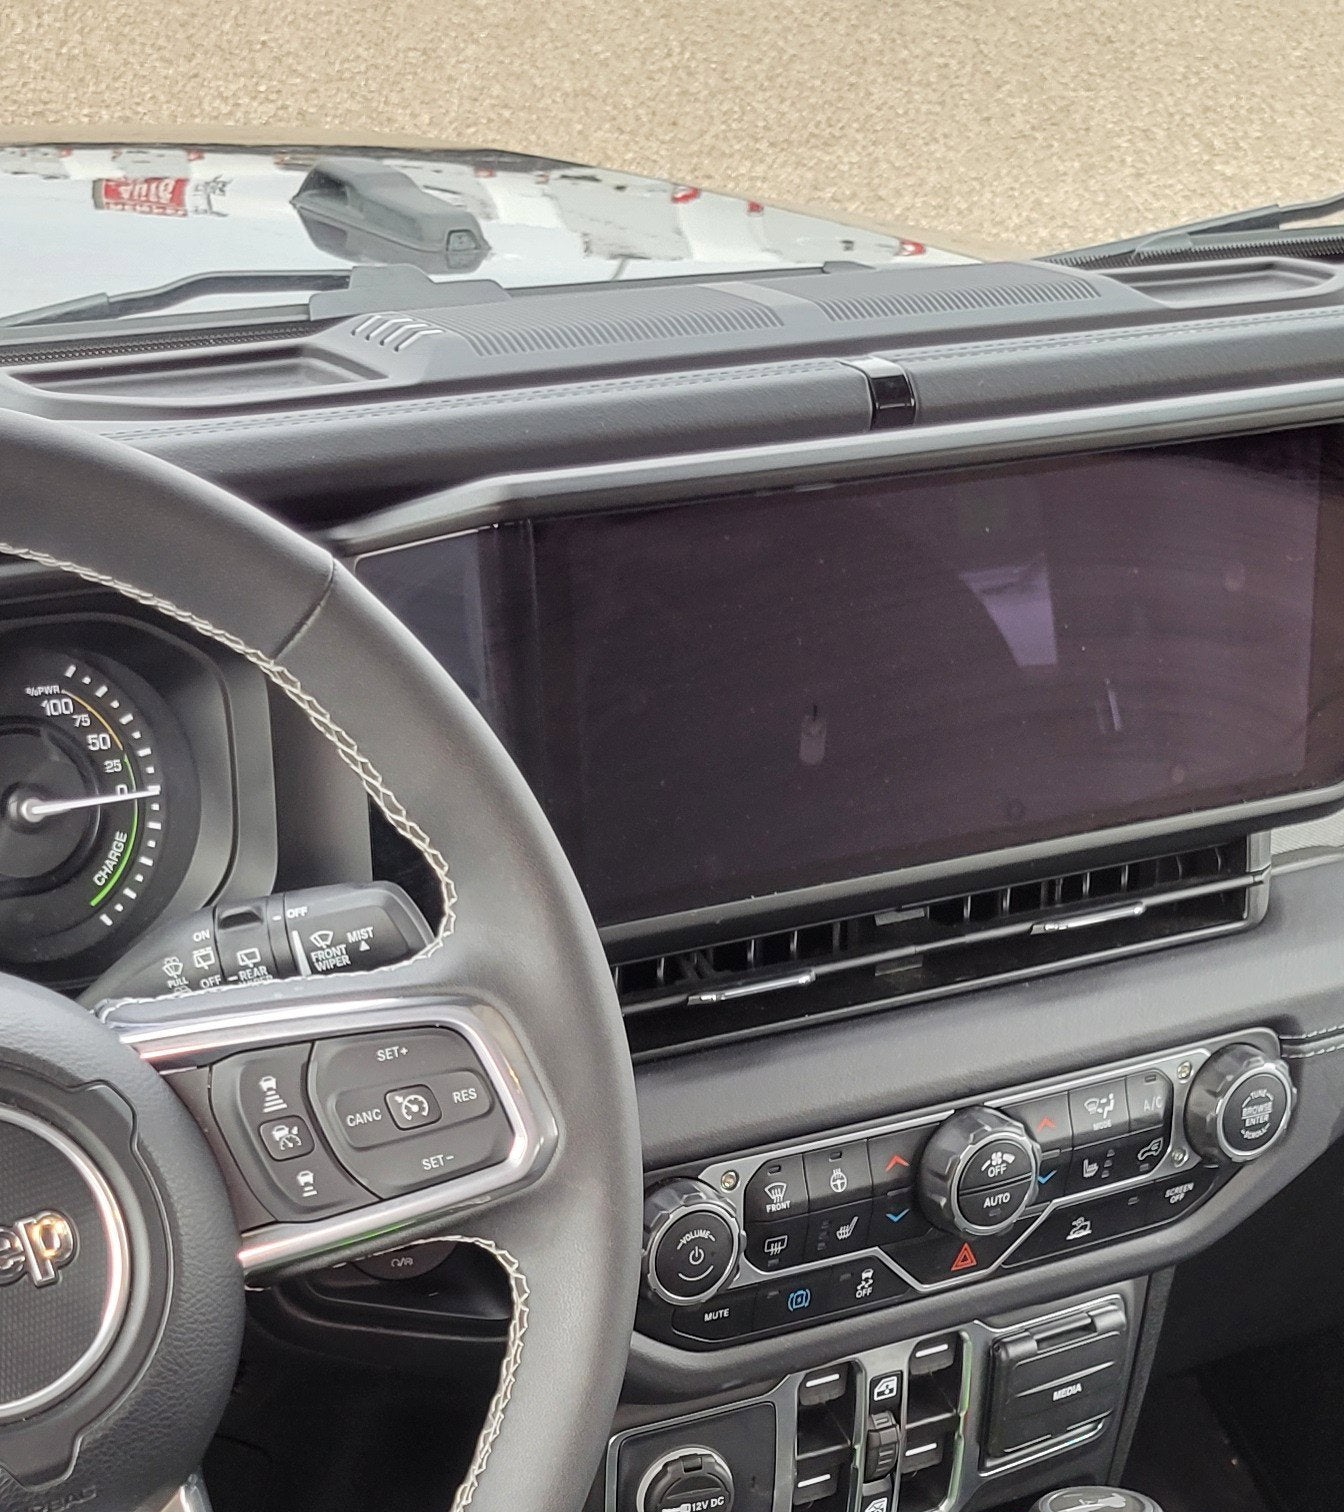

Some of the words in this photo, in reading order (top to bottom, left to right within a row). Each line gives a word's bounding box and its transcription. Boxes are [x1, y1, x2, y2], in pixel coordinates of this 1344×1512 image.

[41, 698, 74, 716] 100
[73, 714, 91, 728] 75
[86, 733, 111, 751] 50
[104, 759, 123, 773] 25
[92, 830, 128, 887] CHARGE
[286, 906, 308, 920] OFF
[192, 929, 211, 942] ON
[347, 926, 374, 943] MIST
[311, 944, 348, 963] FRONT
[315, 954, 351, 973] WIPER
[200, 974, 222, 989] OFF
[238, 965, 269, 981] REAR
[452, 1087, 478, 1105] RES
[1142, 1096, 1164, 1113] A/C
[346, 1108, 383, 1127] CANC
[987, 1165, 1007, 1178] OFF
[1164, 1182, 1195, 1199] SCREEN
[1169, 1191, 1186, 1204] OFF
[766, 1200, 792, 1213] FRONT
[983, 1192, 1011, 1209] AUTO
[855, 1286, 873, 1299] OFF
[703, 1307, 731, 1322] MUTE
[1052, 1383, 1083, 1401] MEDIA
[692, 1499, 709, 1512] 12V
[710, 1495, 725, 1508] DC
